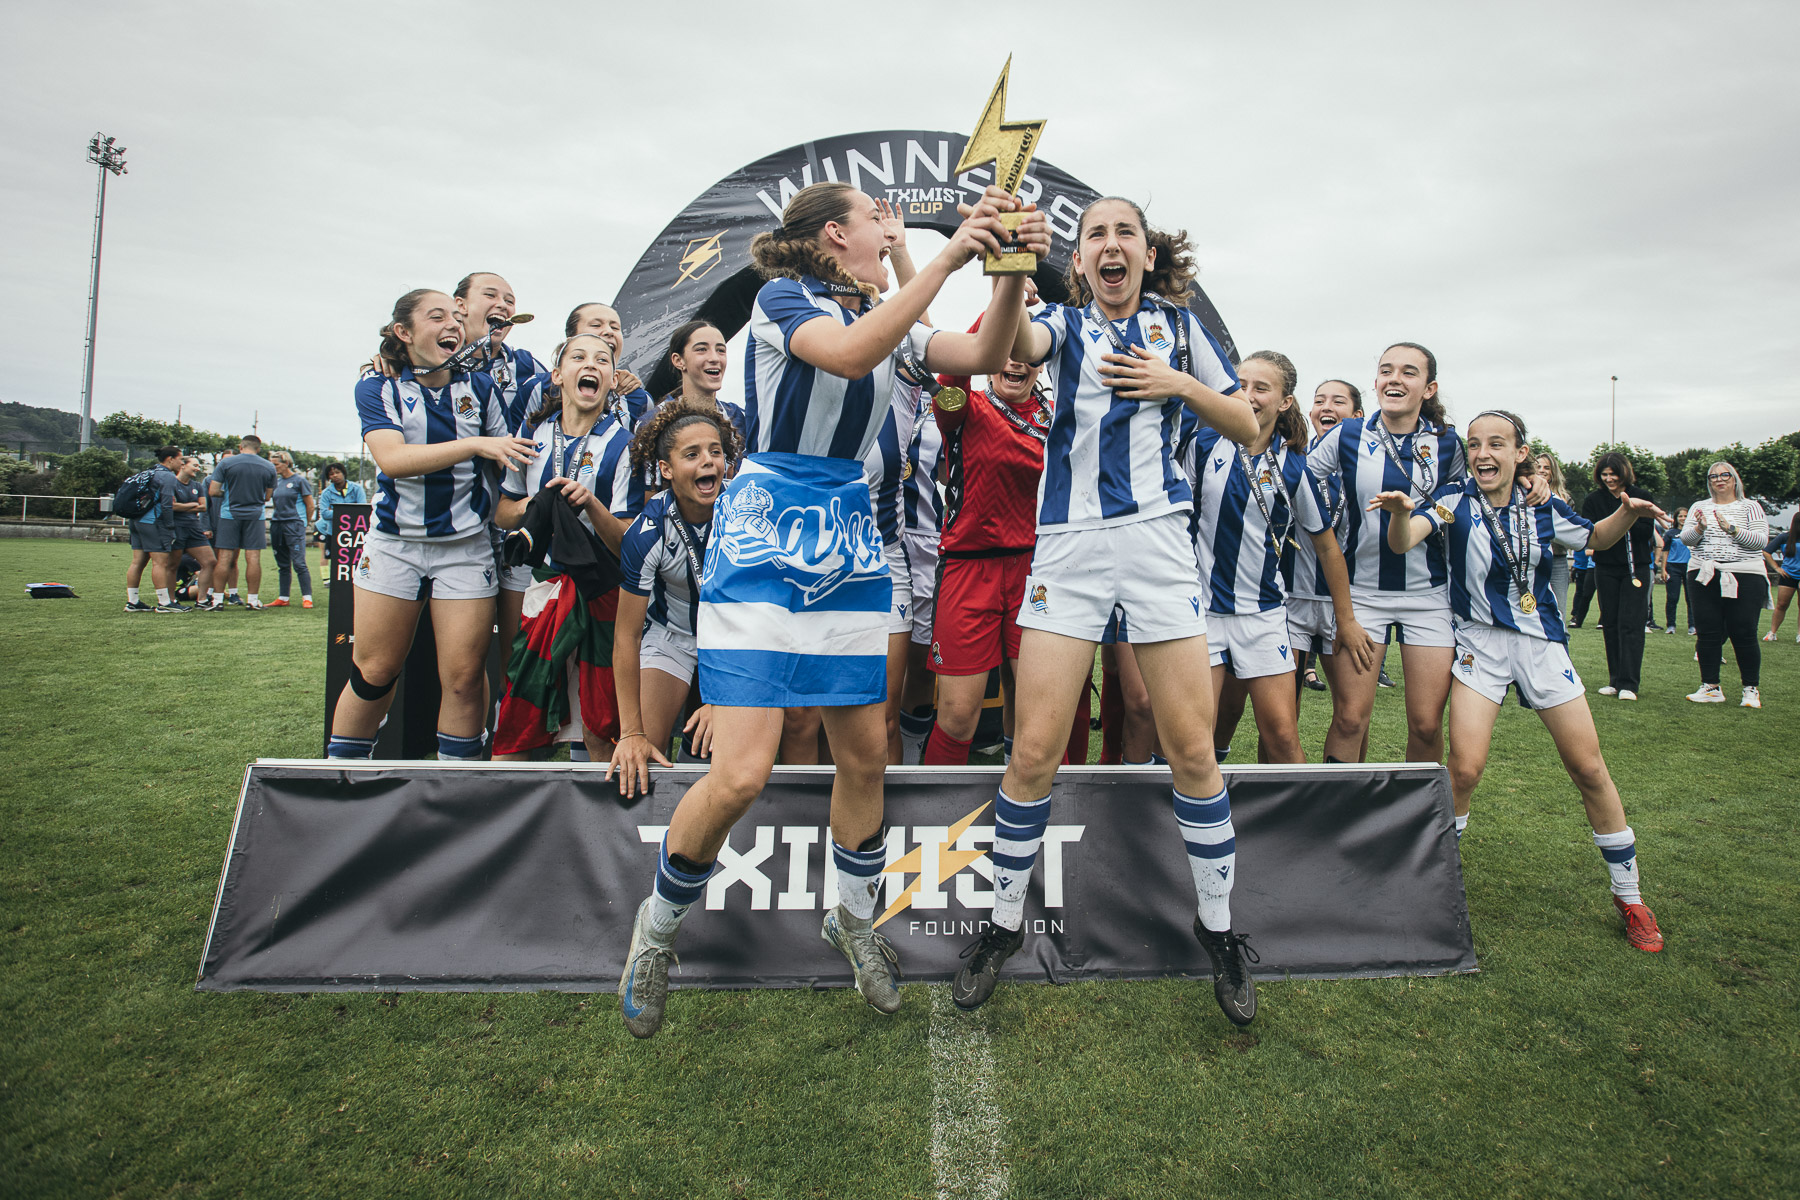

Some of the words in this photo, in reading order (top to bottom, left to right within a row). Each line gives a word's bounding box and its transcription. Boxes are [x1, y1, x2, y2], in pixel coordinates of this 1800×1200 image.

[1021, 126, 1033, 150] CUP
[884, 187, 967, 204] TXIMIST
[909, 202, 943, 215] CUP
[1100, 323, 1118, 347] TXIMIST
[1177, 322, 1188, 351] TXIMIST
[903, 352, 924, 380] TXIMIST
[1181, 355, 1189, 374] TXIM
[1007, 410, 1028, 428] TXIMIST
[1241, 453, 1253, 476] TXIMIST
[1250, 477, 1262, 501] TXIMIST
[1271, 464, 1284, 487] TXIMIST
[1480, 494, 1493, 515] TXIMIST
[1491, 516, 1506, 540] TXIMIST
[1502, 541, 1515, 563] TXIMIST
[674, 518, 690, 543] TXIMIST
[688, 545, 700, 572] TXIMIST
[637, 825, 1086, 911] XIIST
[909, 919, 1064, 936] FOUNDION
